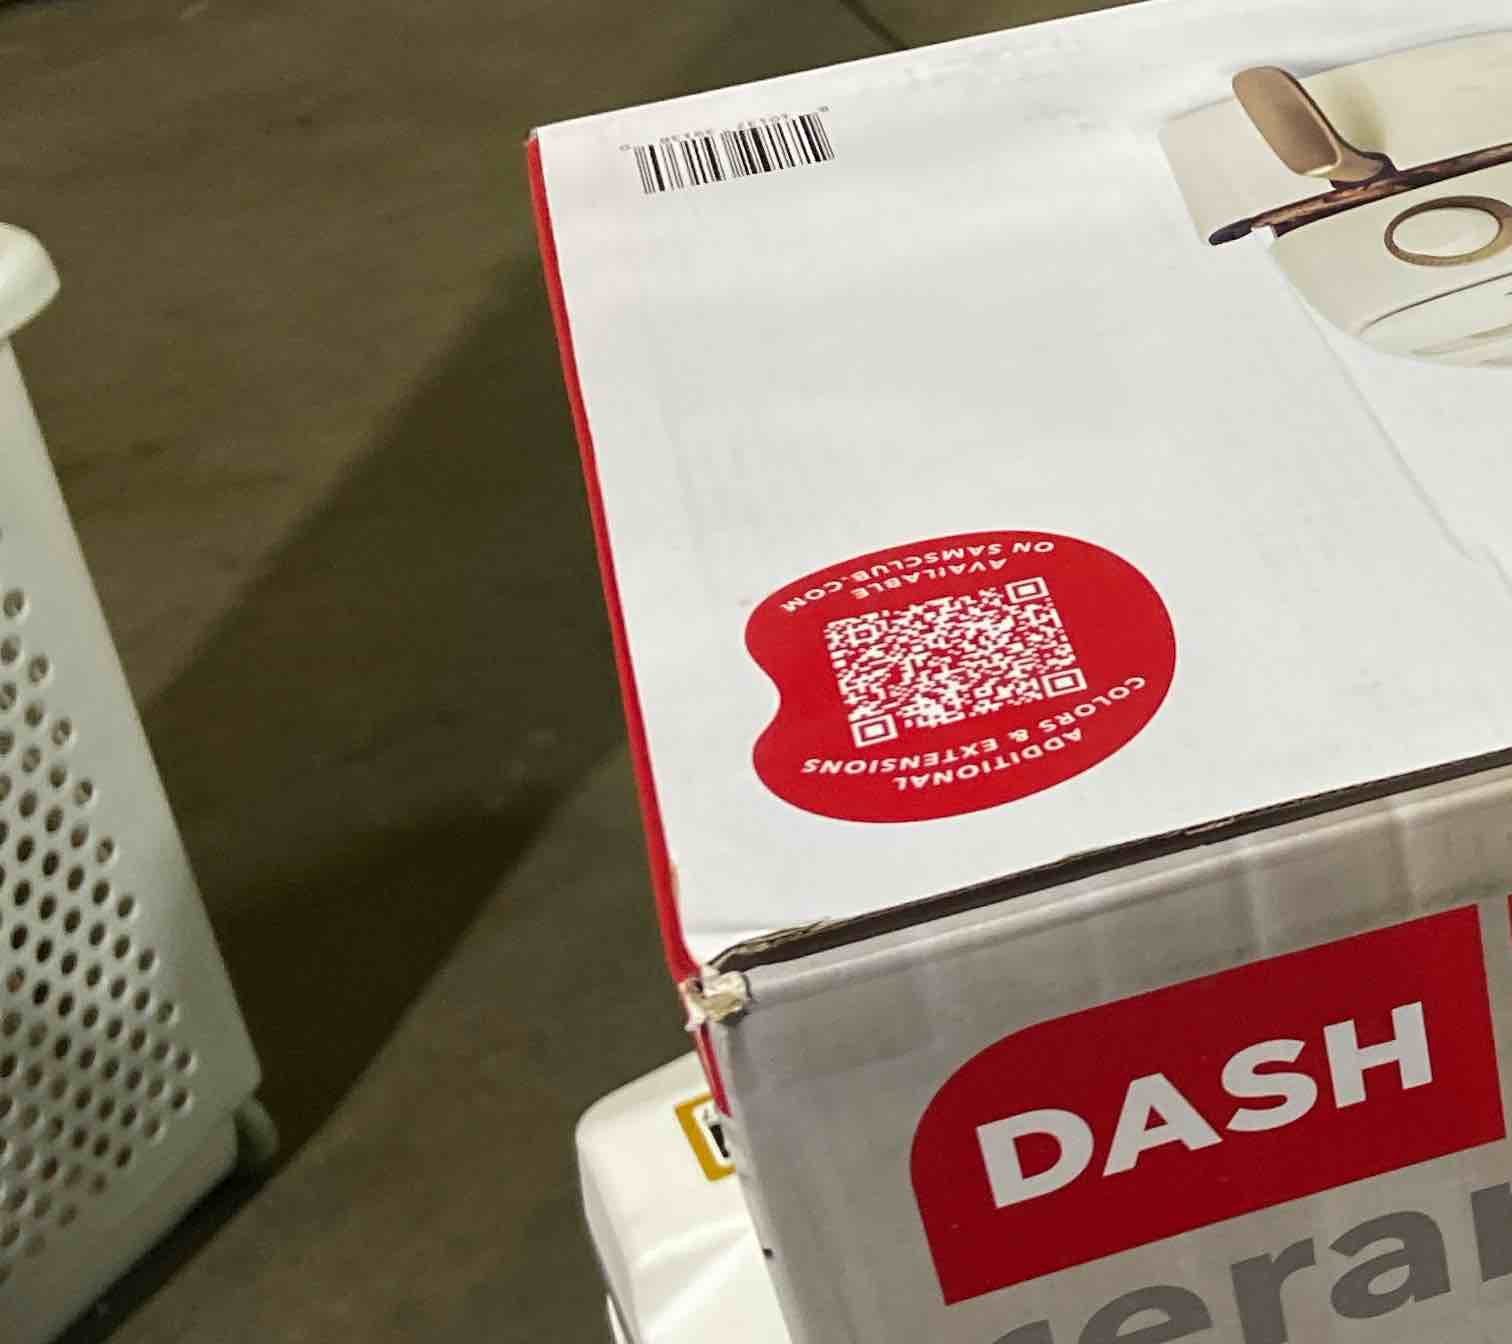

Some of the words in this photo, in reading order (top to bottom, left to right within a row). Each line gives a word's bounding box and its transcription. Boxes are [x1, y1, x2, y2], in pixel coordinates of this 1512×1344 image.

[1012, 541, 1055, 553] ON
[781, 543, 1001, 612] SAMSCLUB.COM
[851, 559, 1007, 599] AVAILABLE
[1038, 677, 1146, 731] COLORS
[801, 738, 998, 774] EXTENSIONS
[893, 728, 1082, 790] ADDITIONAL
[1008, 729, 1029, 742] &
[977, 1001, 1433, 1209] DASH
